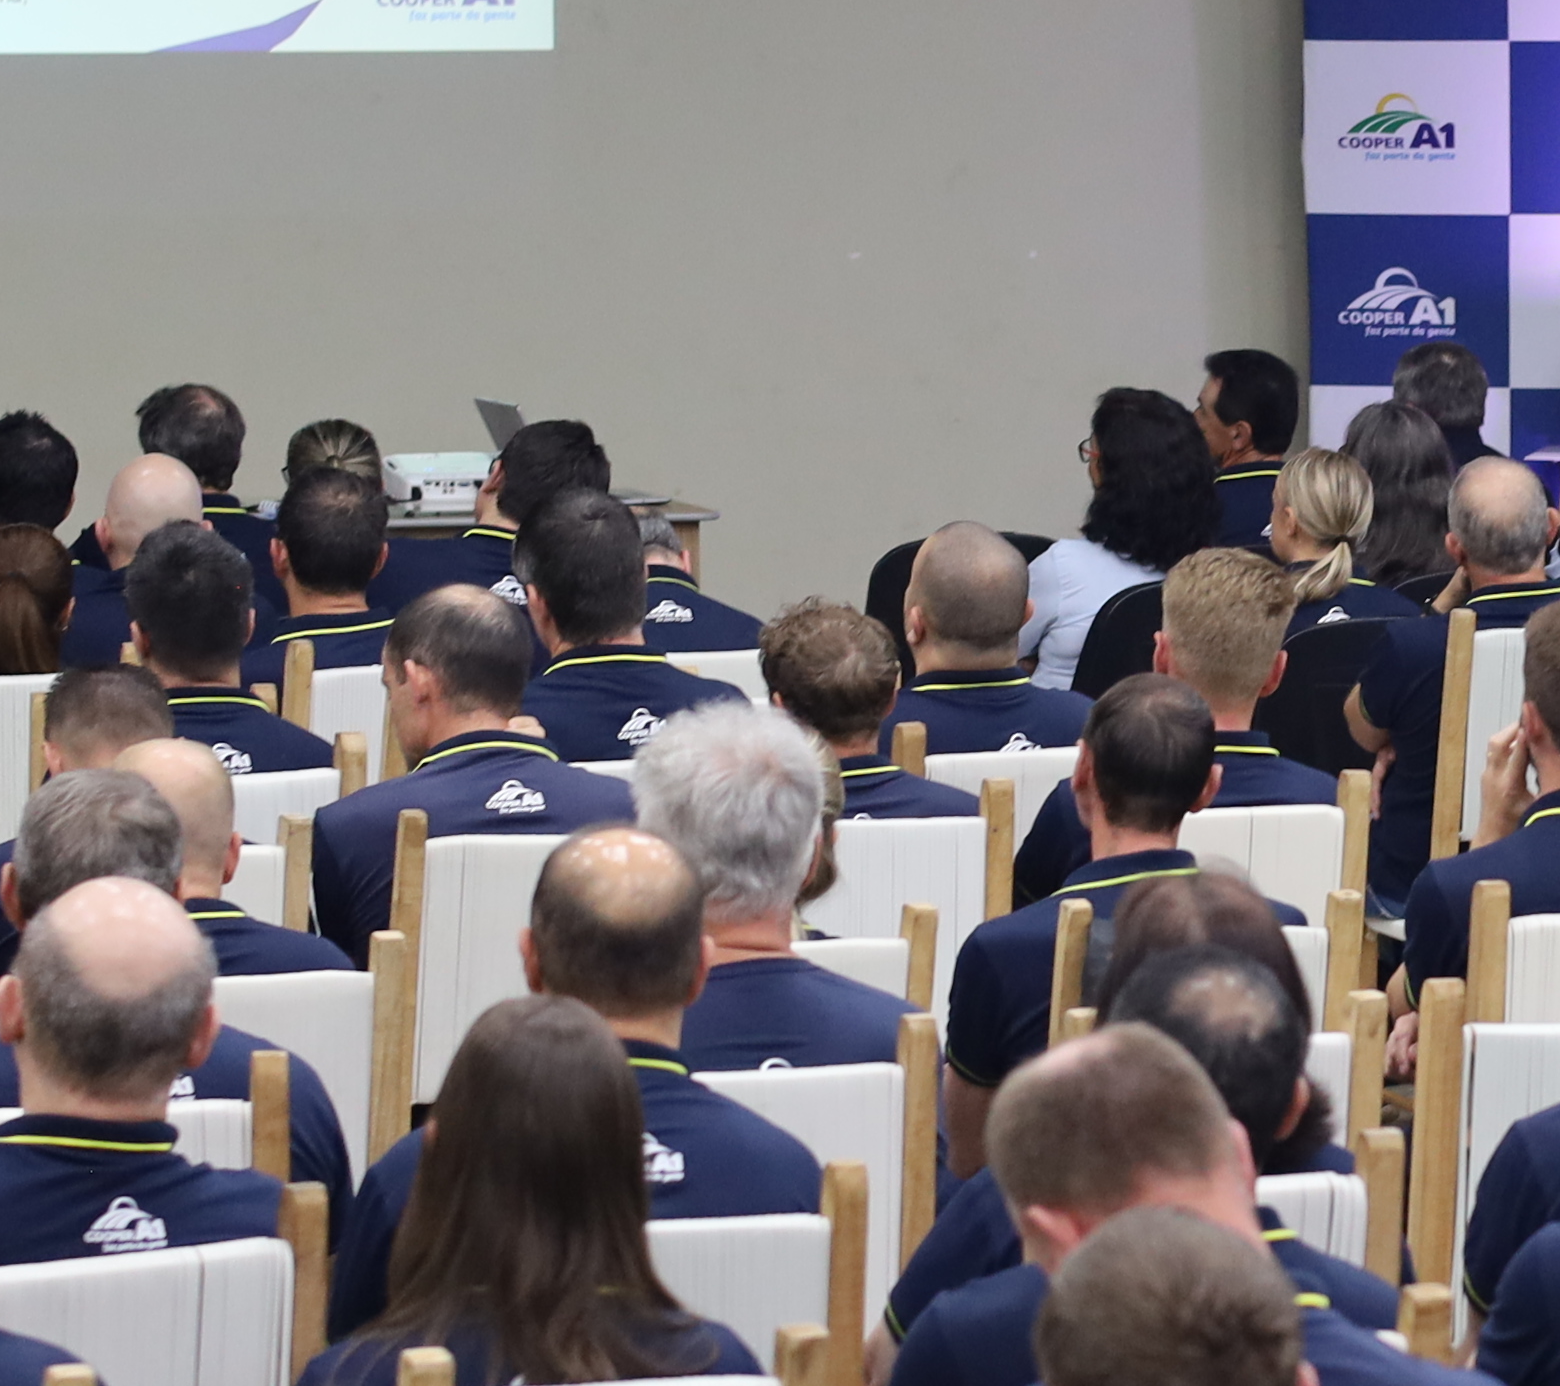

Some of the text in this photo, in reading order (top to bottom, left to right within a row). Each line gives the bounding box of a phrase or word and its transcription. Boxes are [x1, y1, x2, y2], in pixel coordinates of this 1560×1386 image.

[1338, 122, 1455, 149] COOPER A1
[1338, 297, 1455, 325] COOPER A1
[136, 1218, 167, 1241] A1
